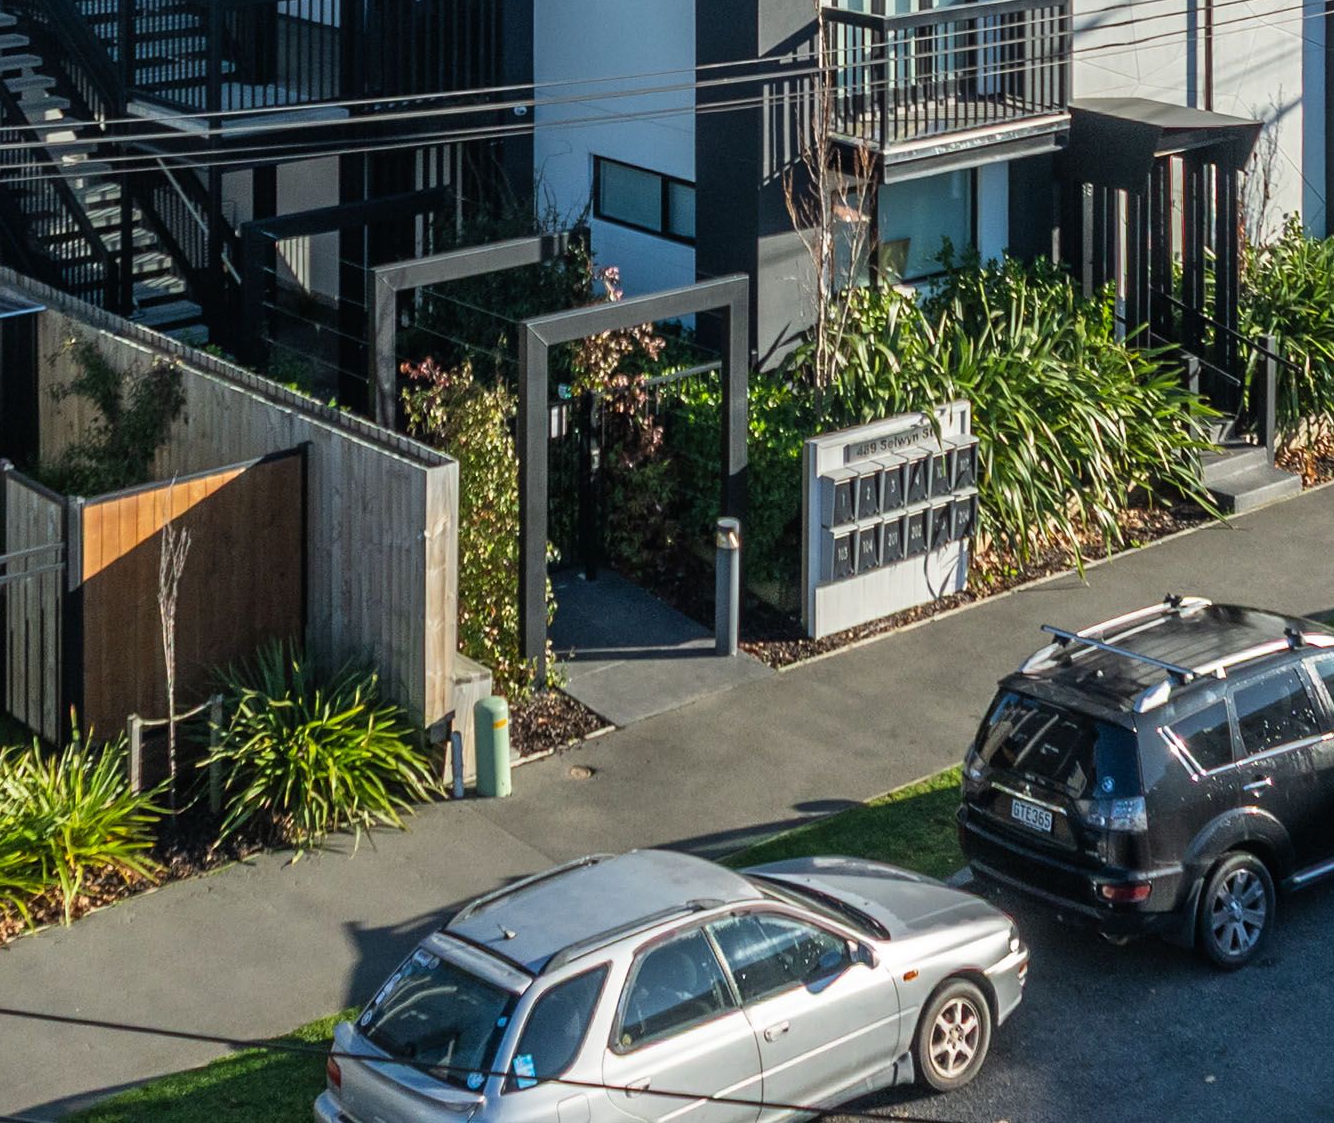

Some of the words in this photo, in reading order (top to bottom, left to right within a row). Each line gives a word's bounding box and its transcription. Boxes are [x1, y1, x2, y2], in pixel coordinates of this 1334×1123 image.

[857, 442, 877, 457] 489
[880, 433, 919, 451] Selwyn
[922, 427, 933, 440] St
[911, 523, 922, 540] 202
[838, 547, 849, 562] 103
[862, 539, 873, 554] 104
[1013, 802, 1051, 829] GTE365
